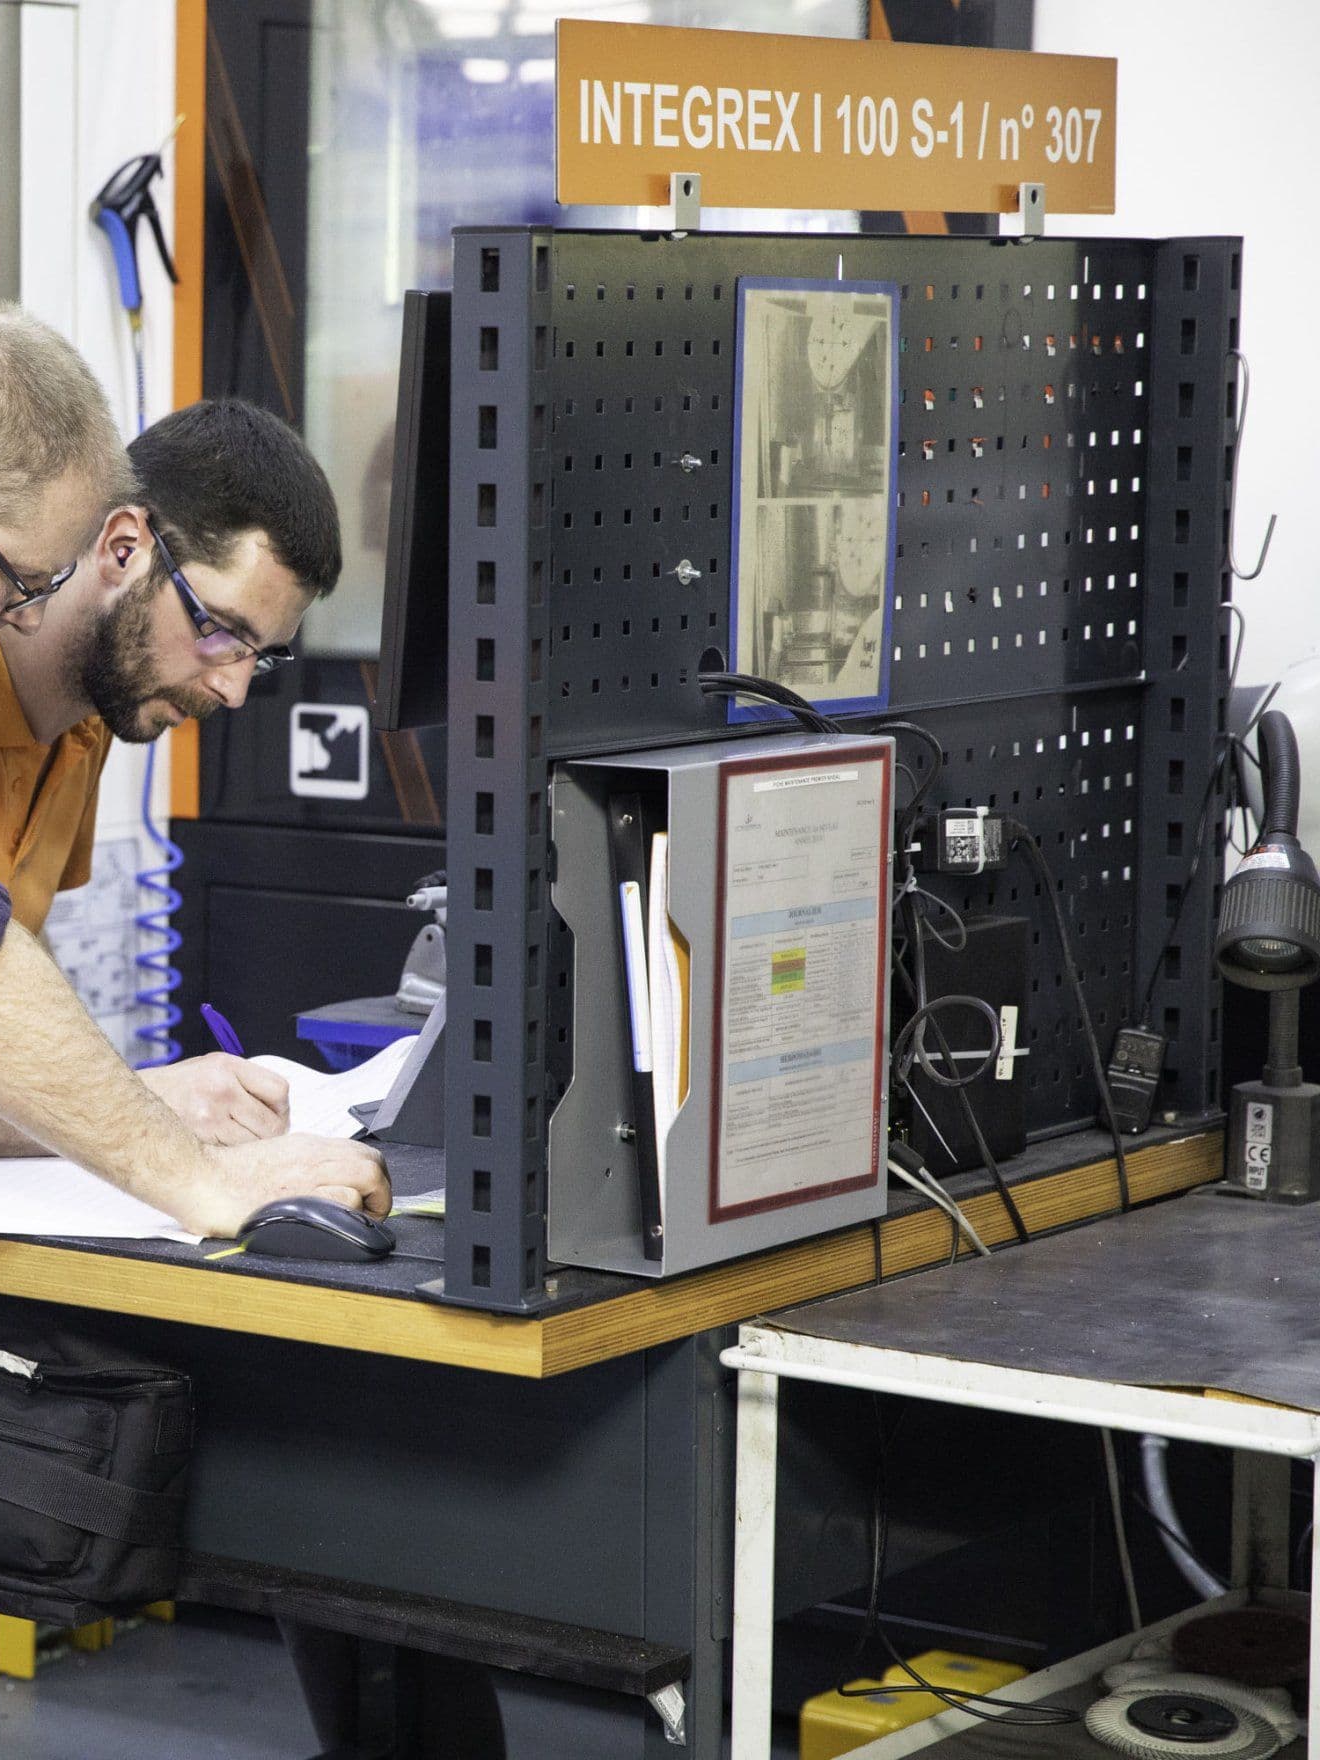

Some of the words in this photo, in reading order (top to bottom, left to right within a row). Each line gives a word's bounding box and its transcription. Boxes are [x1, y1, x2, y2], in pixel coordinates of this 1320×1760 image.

[580, 79, 801, 152] INTEGREX
[836, 94, 900, 157] 100
[910, 97, 964, 160] S-1
[977, 100, 991, 161] /
[1045, 105, 1102, 164] 307
[1248, 1145, 1270, 1163] CE
